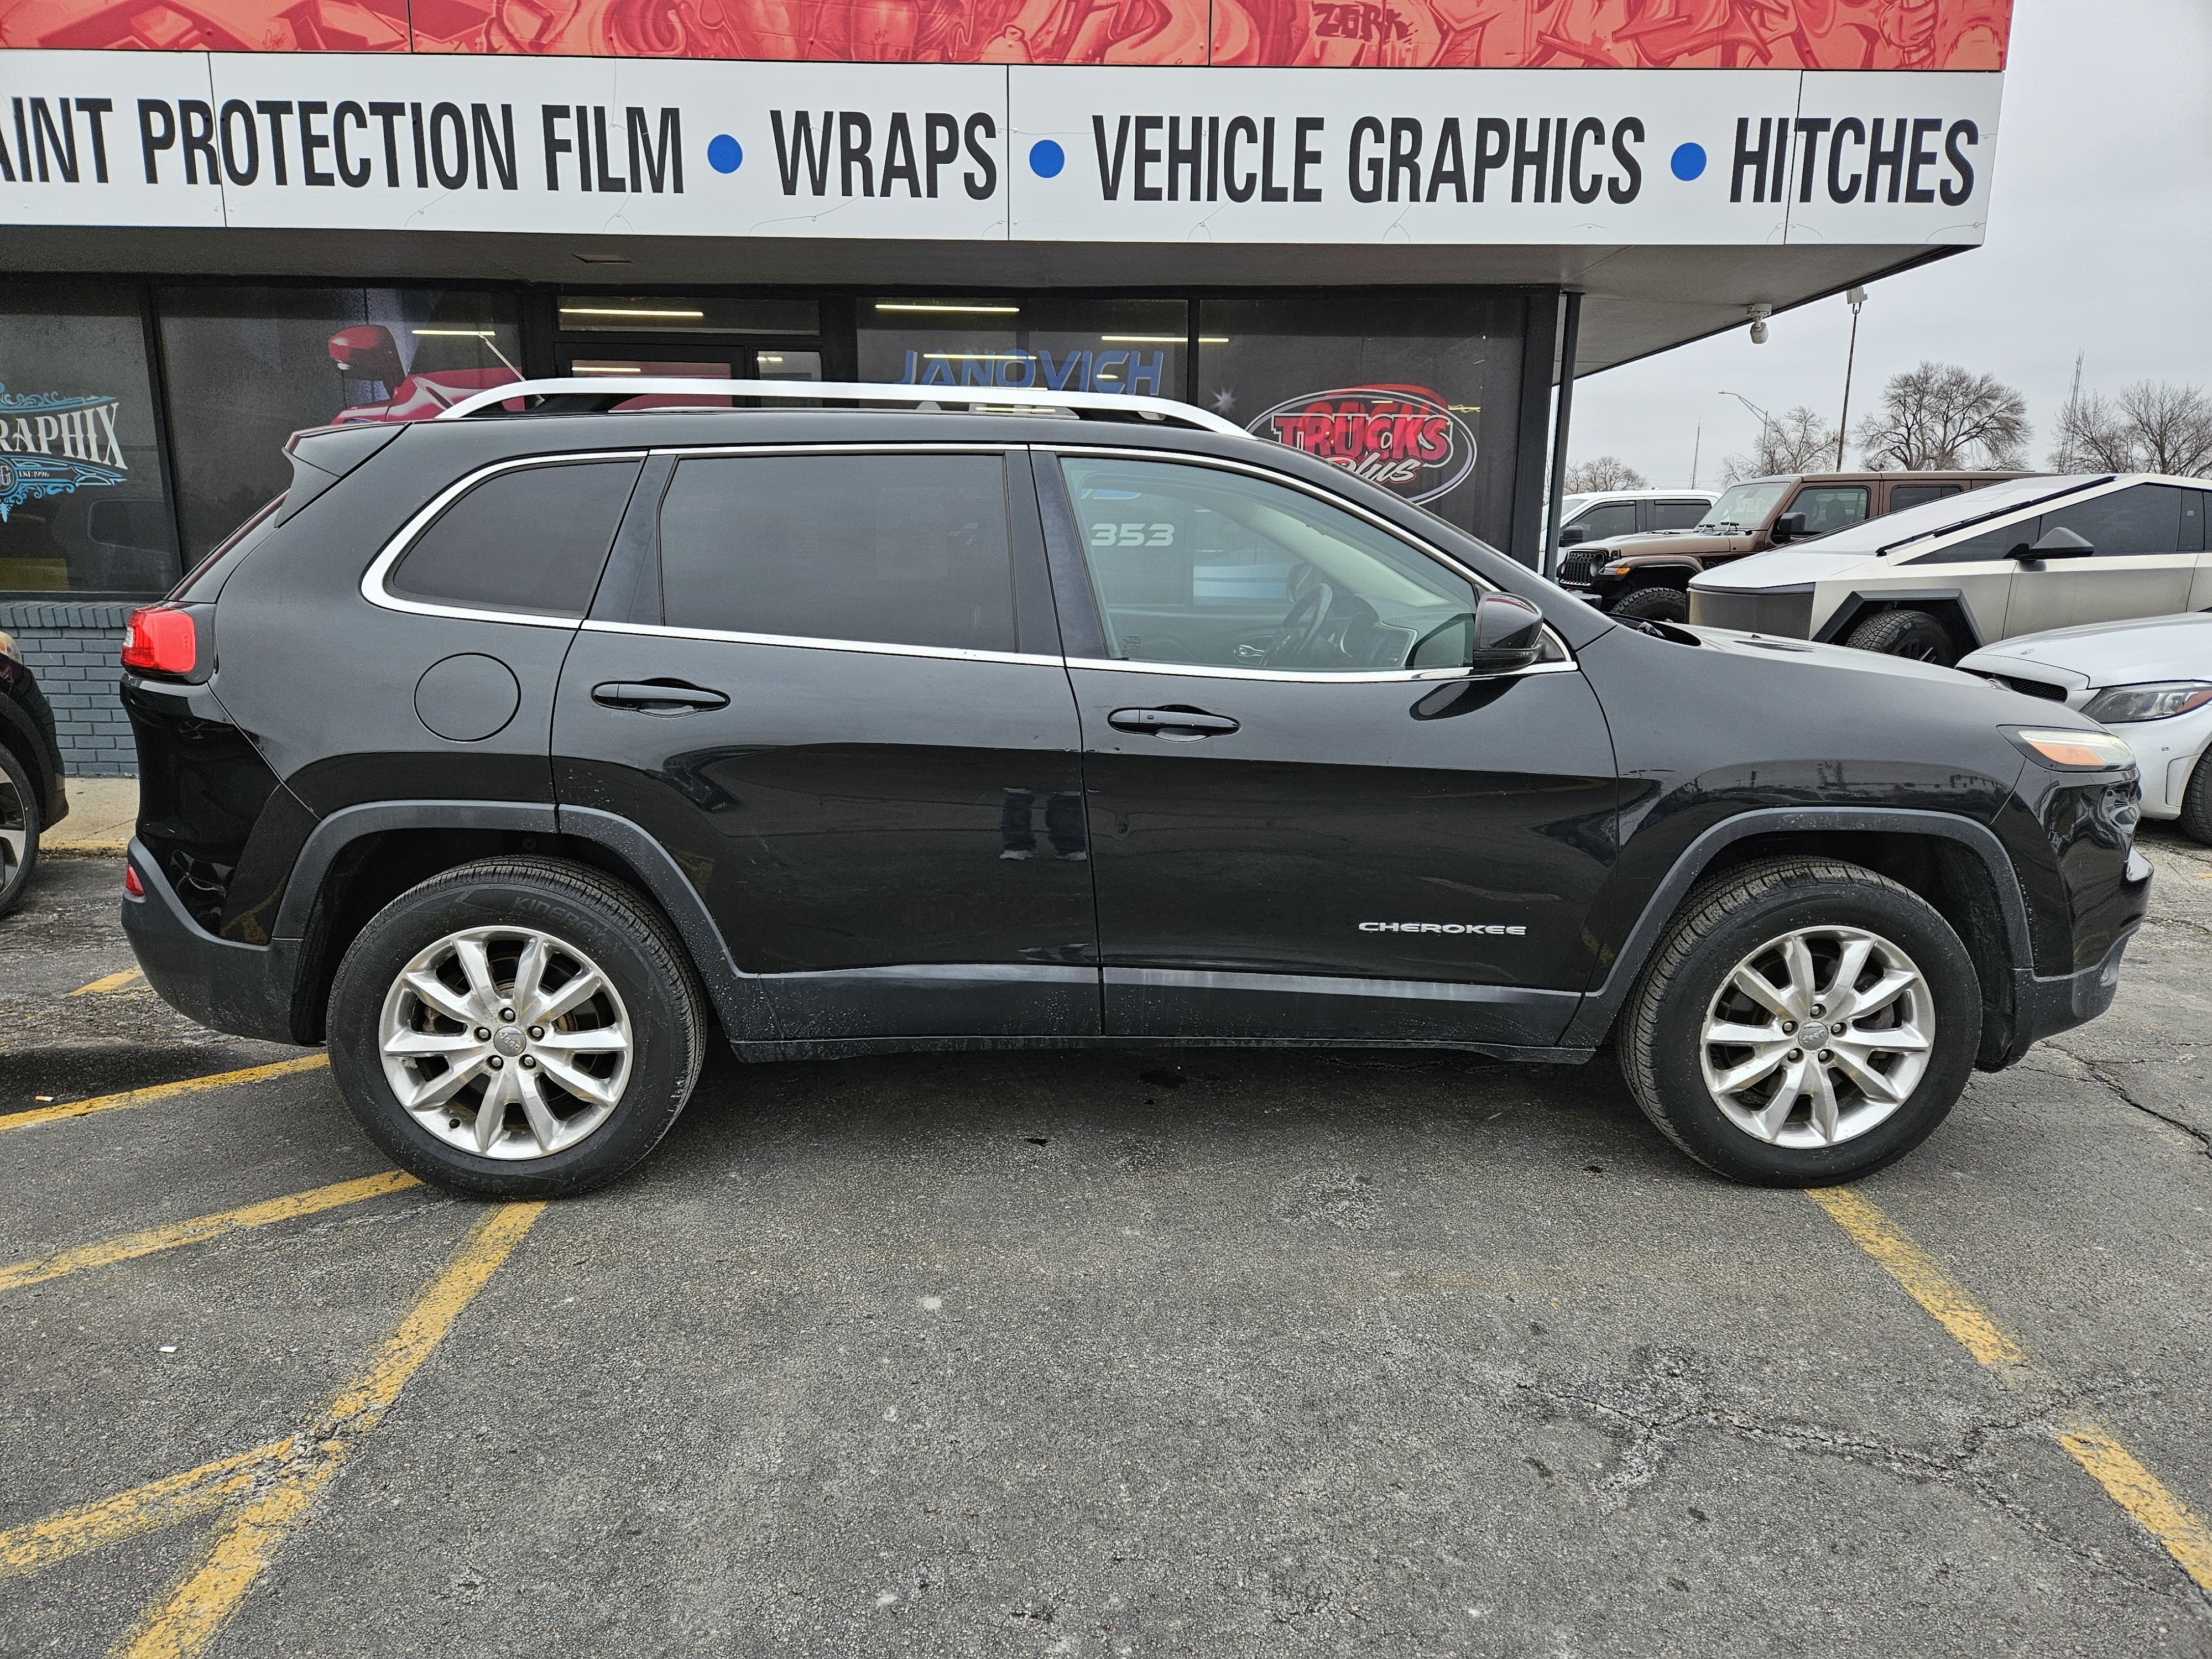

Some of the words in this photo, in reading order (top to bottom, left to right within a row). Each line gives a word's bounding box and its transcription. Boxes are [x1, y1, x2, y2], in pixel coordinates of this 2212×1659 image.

[137, 98, 518, 190] PROTECTION
[541, 104, 684, 194] FILM
[769, 109, 997, 200] WRAPS
[1092, 114, 1324, 203] VEHICLE
[1348, 116, 1645, 205] GRAPHICS
[1730, 117, 1979, 206] HITCHES
[893, 349, 1164, 396] JANOVICH
[1272, 413, 1453, 466] TRUCKS
[1091, 523, 1175, 546] 353
[1359, 922, 1527, 935] CHEROKEE
